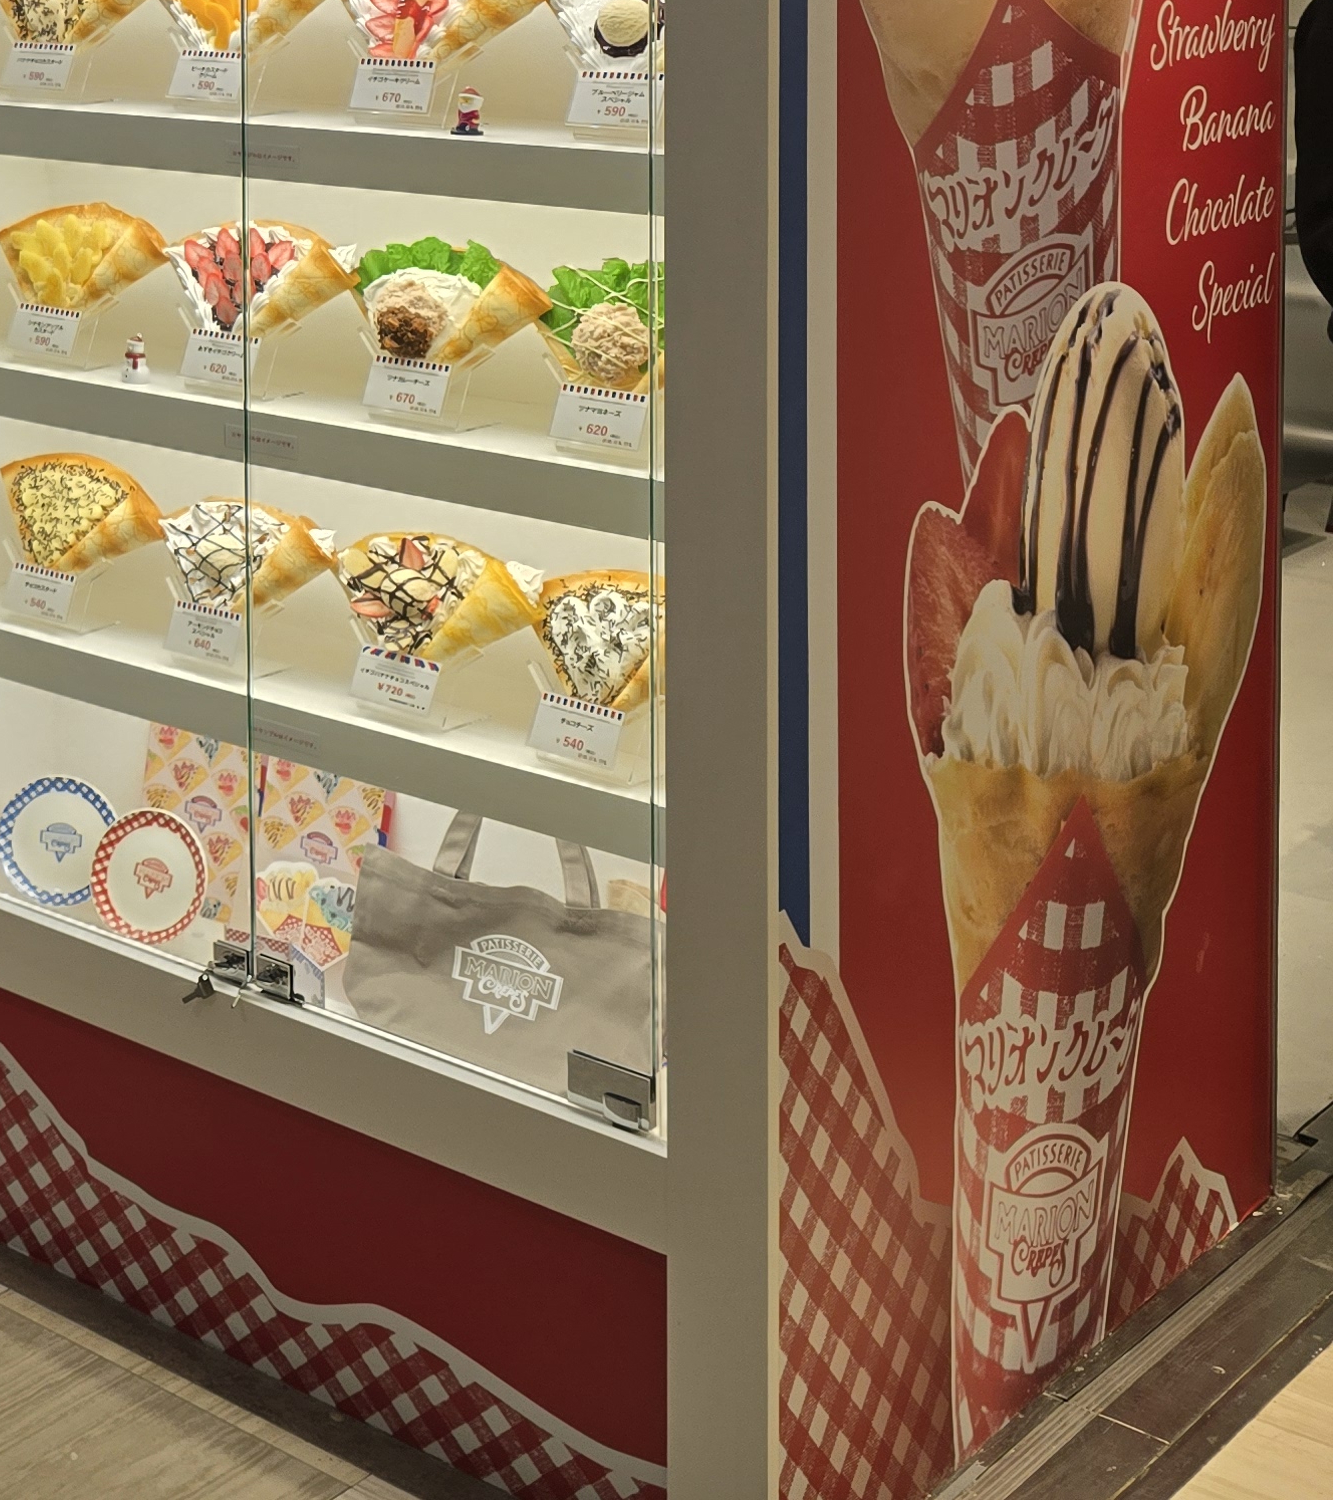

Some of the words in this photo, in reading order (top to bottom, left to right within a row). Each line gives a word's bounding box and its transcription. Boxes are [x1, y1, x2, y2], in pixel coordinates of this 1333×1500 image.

[197, 80, 215, 90] 590
[382, 92, 401, 103] 670
[604, 106, 626, 116] 590
[1180, 84, 1277, 154] Banana
[1164, 173, 1277, 249] Chocolate
[994, 251, 1067, 308] PATISSERIE
[1190, 251, 1277, 346] Special
[983, 265, 1083, 359] MARION
[35, 335, 50, 346] 590
[210, 363, 227, 374] 620
[396, 392, 416, 404] 670
[586, 423, 608, 436] 620
[194, 638, 211, 650] 640
[563, 736, 584, 751] 540
[480, 938, 542, 968] PATISSERIE
[464, 956, 554, 1000] MARION
[1014, 1142, 1083, 1180] PATISSERIE
[994, 1178, 1095, 1248] MARION
